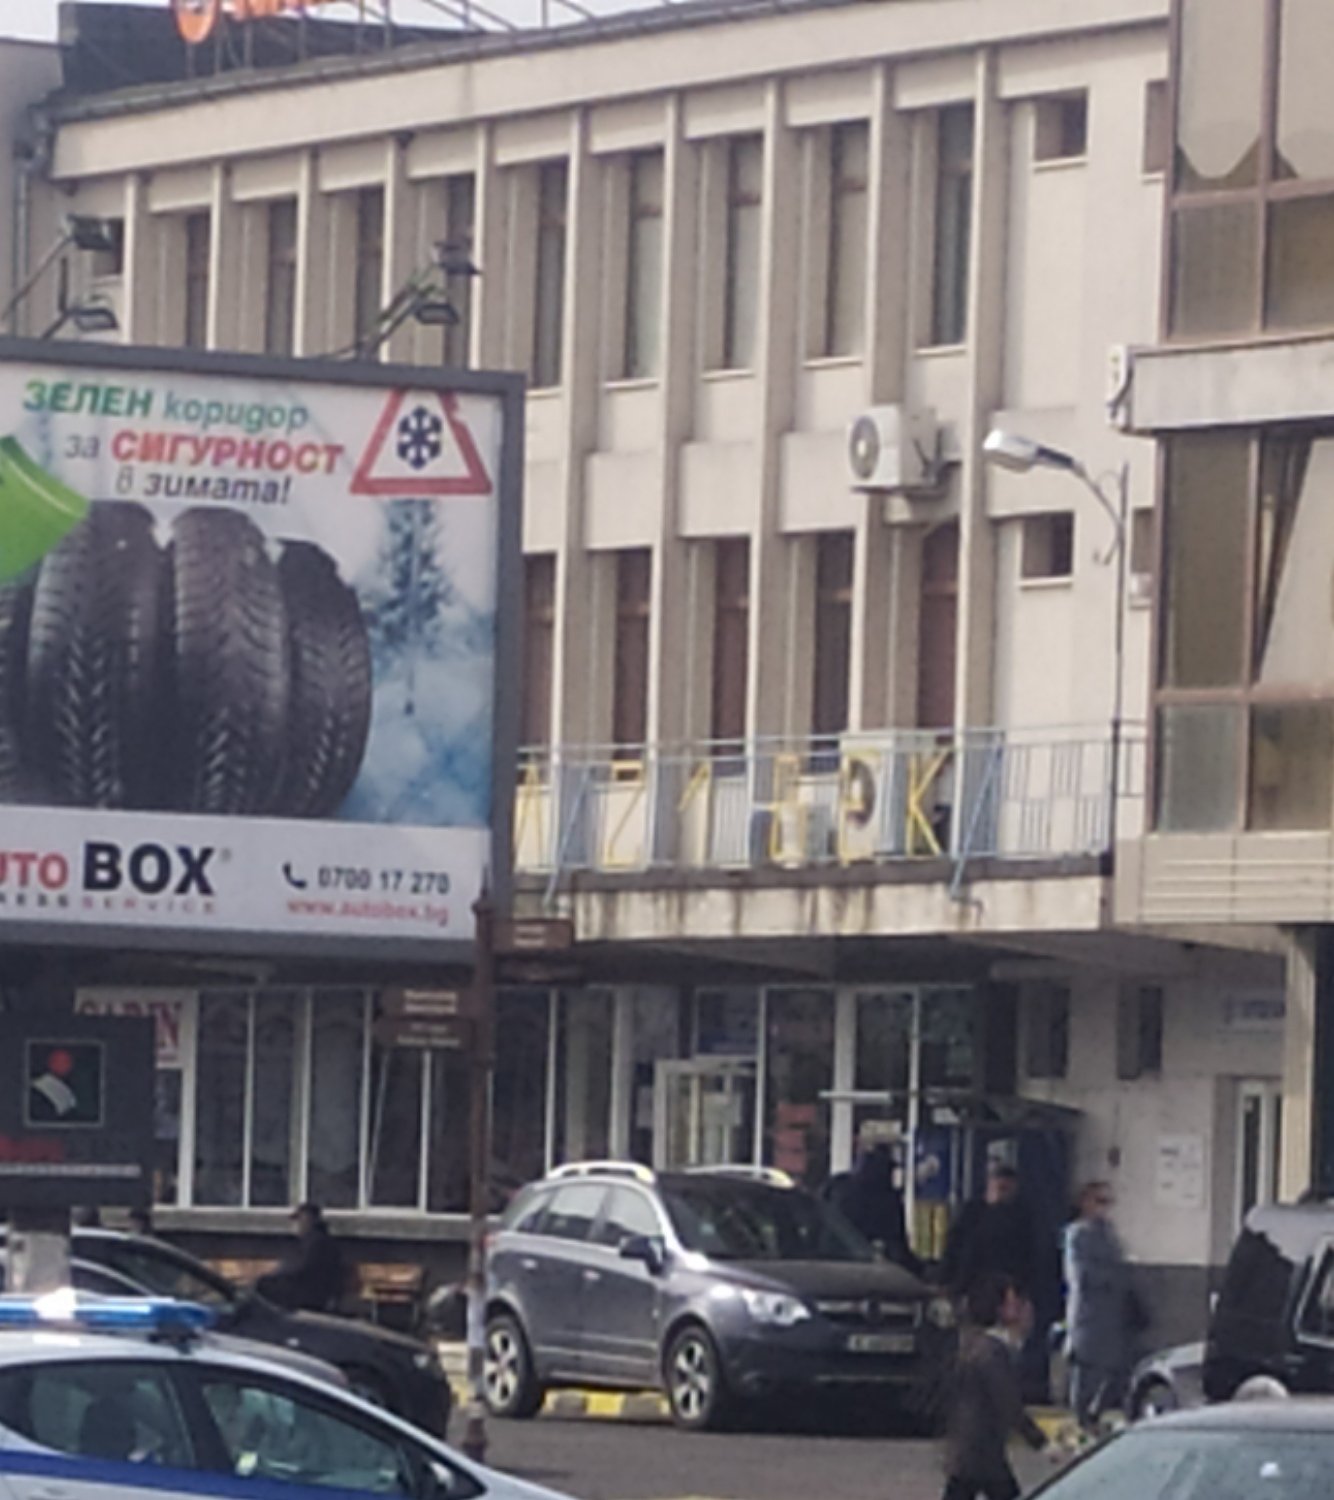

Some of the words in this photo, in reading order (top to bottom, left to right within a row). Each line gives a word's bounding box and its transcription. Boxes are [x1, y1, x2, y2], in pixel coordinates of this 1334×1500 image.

[23, 380, 153, 417] ЗЕЛЕН
[164, 392, 309, 433] коридор
[64, 434, 99, 460] за
[111, 430, 344, 474] СИГУРНОСТ
[144, 471, 291, 504] зимата!
[318, 866, 372, 890] 0700
[380, 870, 403, 892] 17
[82, 896, 216, 914] SERVICE
[286, 899, 449, 927] www.autobox.bg
